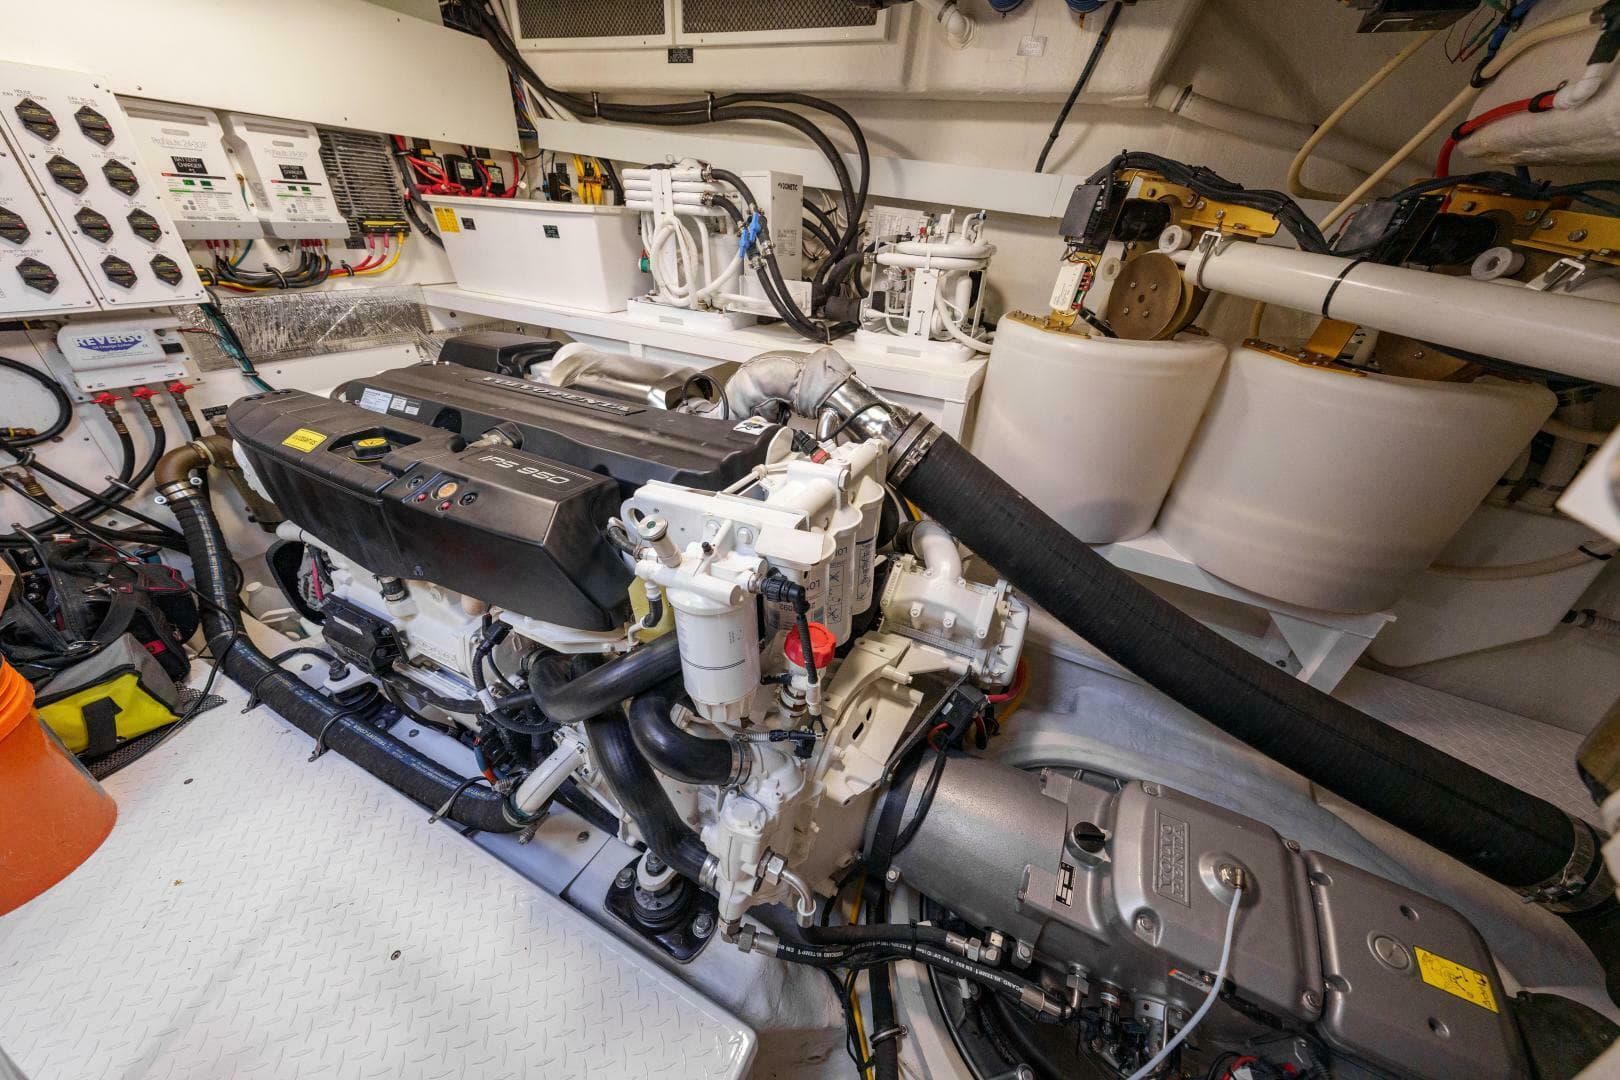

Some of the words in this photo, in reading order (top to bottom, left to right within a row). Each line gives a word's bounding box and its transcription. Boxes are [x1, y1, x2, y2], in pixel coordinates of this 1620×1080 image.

[73, 333, 145, 347] REVERSO
[479, 455, 520, 469] IPS
[517, 466, 570, 484] 950
[1159, 822, 1174, 888] VOLVO
[1172, 823, 1185, 899] PENTA
